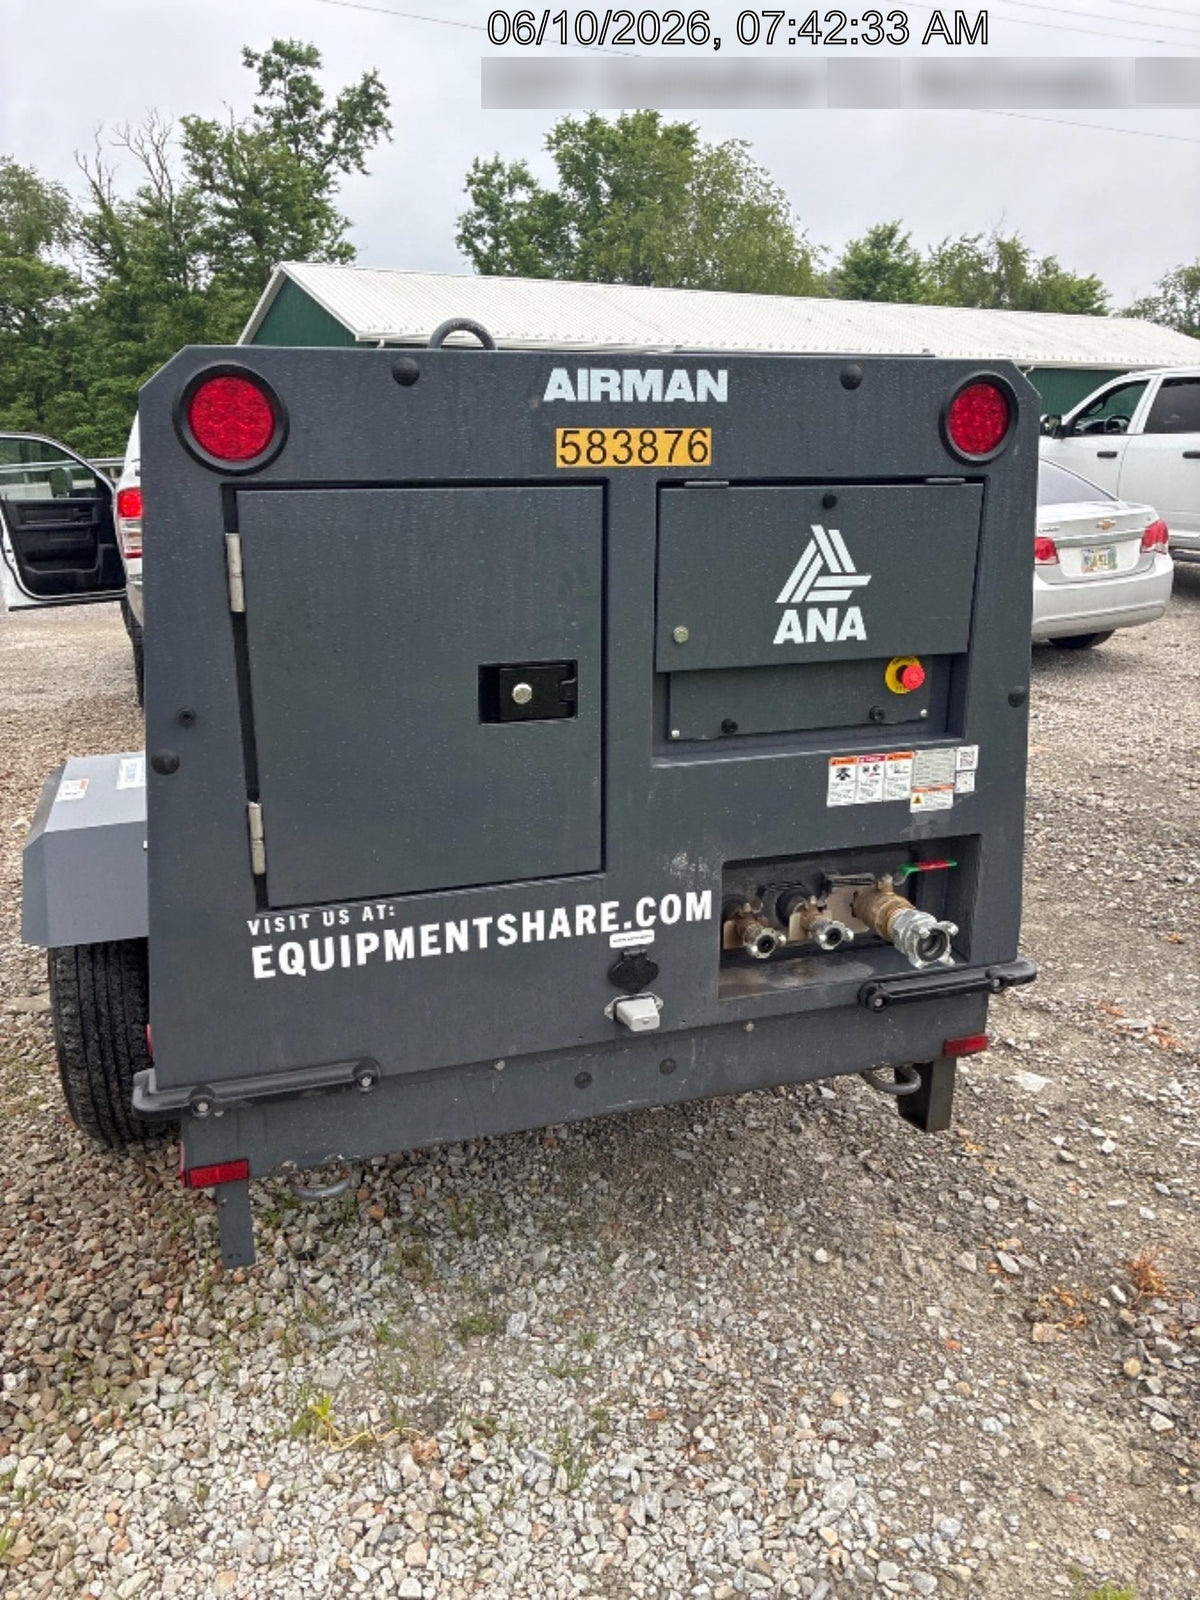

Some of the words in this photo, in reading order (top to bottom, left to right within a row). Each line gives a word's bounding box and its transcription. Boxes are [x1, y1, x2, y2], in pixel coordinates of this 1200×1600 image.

[543, 368, 728, 402] AIRMAN
[559, 429, 709, 465] 583876
[773, 606, 868, 645] ANA
[247, 914, 310, 936] VISIT
[322, 909, 350, 927] US
[362, 904, 396, 922] AT:
[251, 889, 712, 979] EQUIPMENTSHARE.COM
